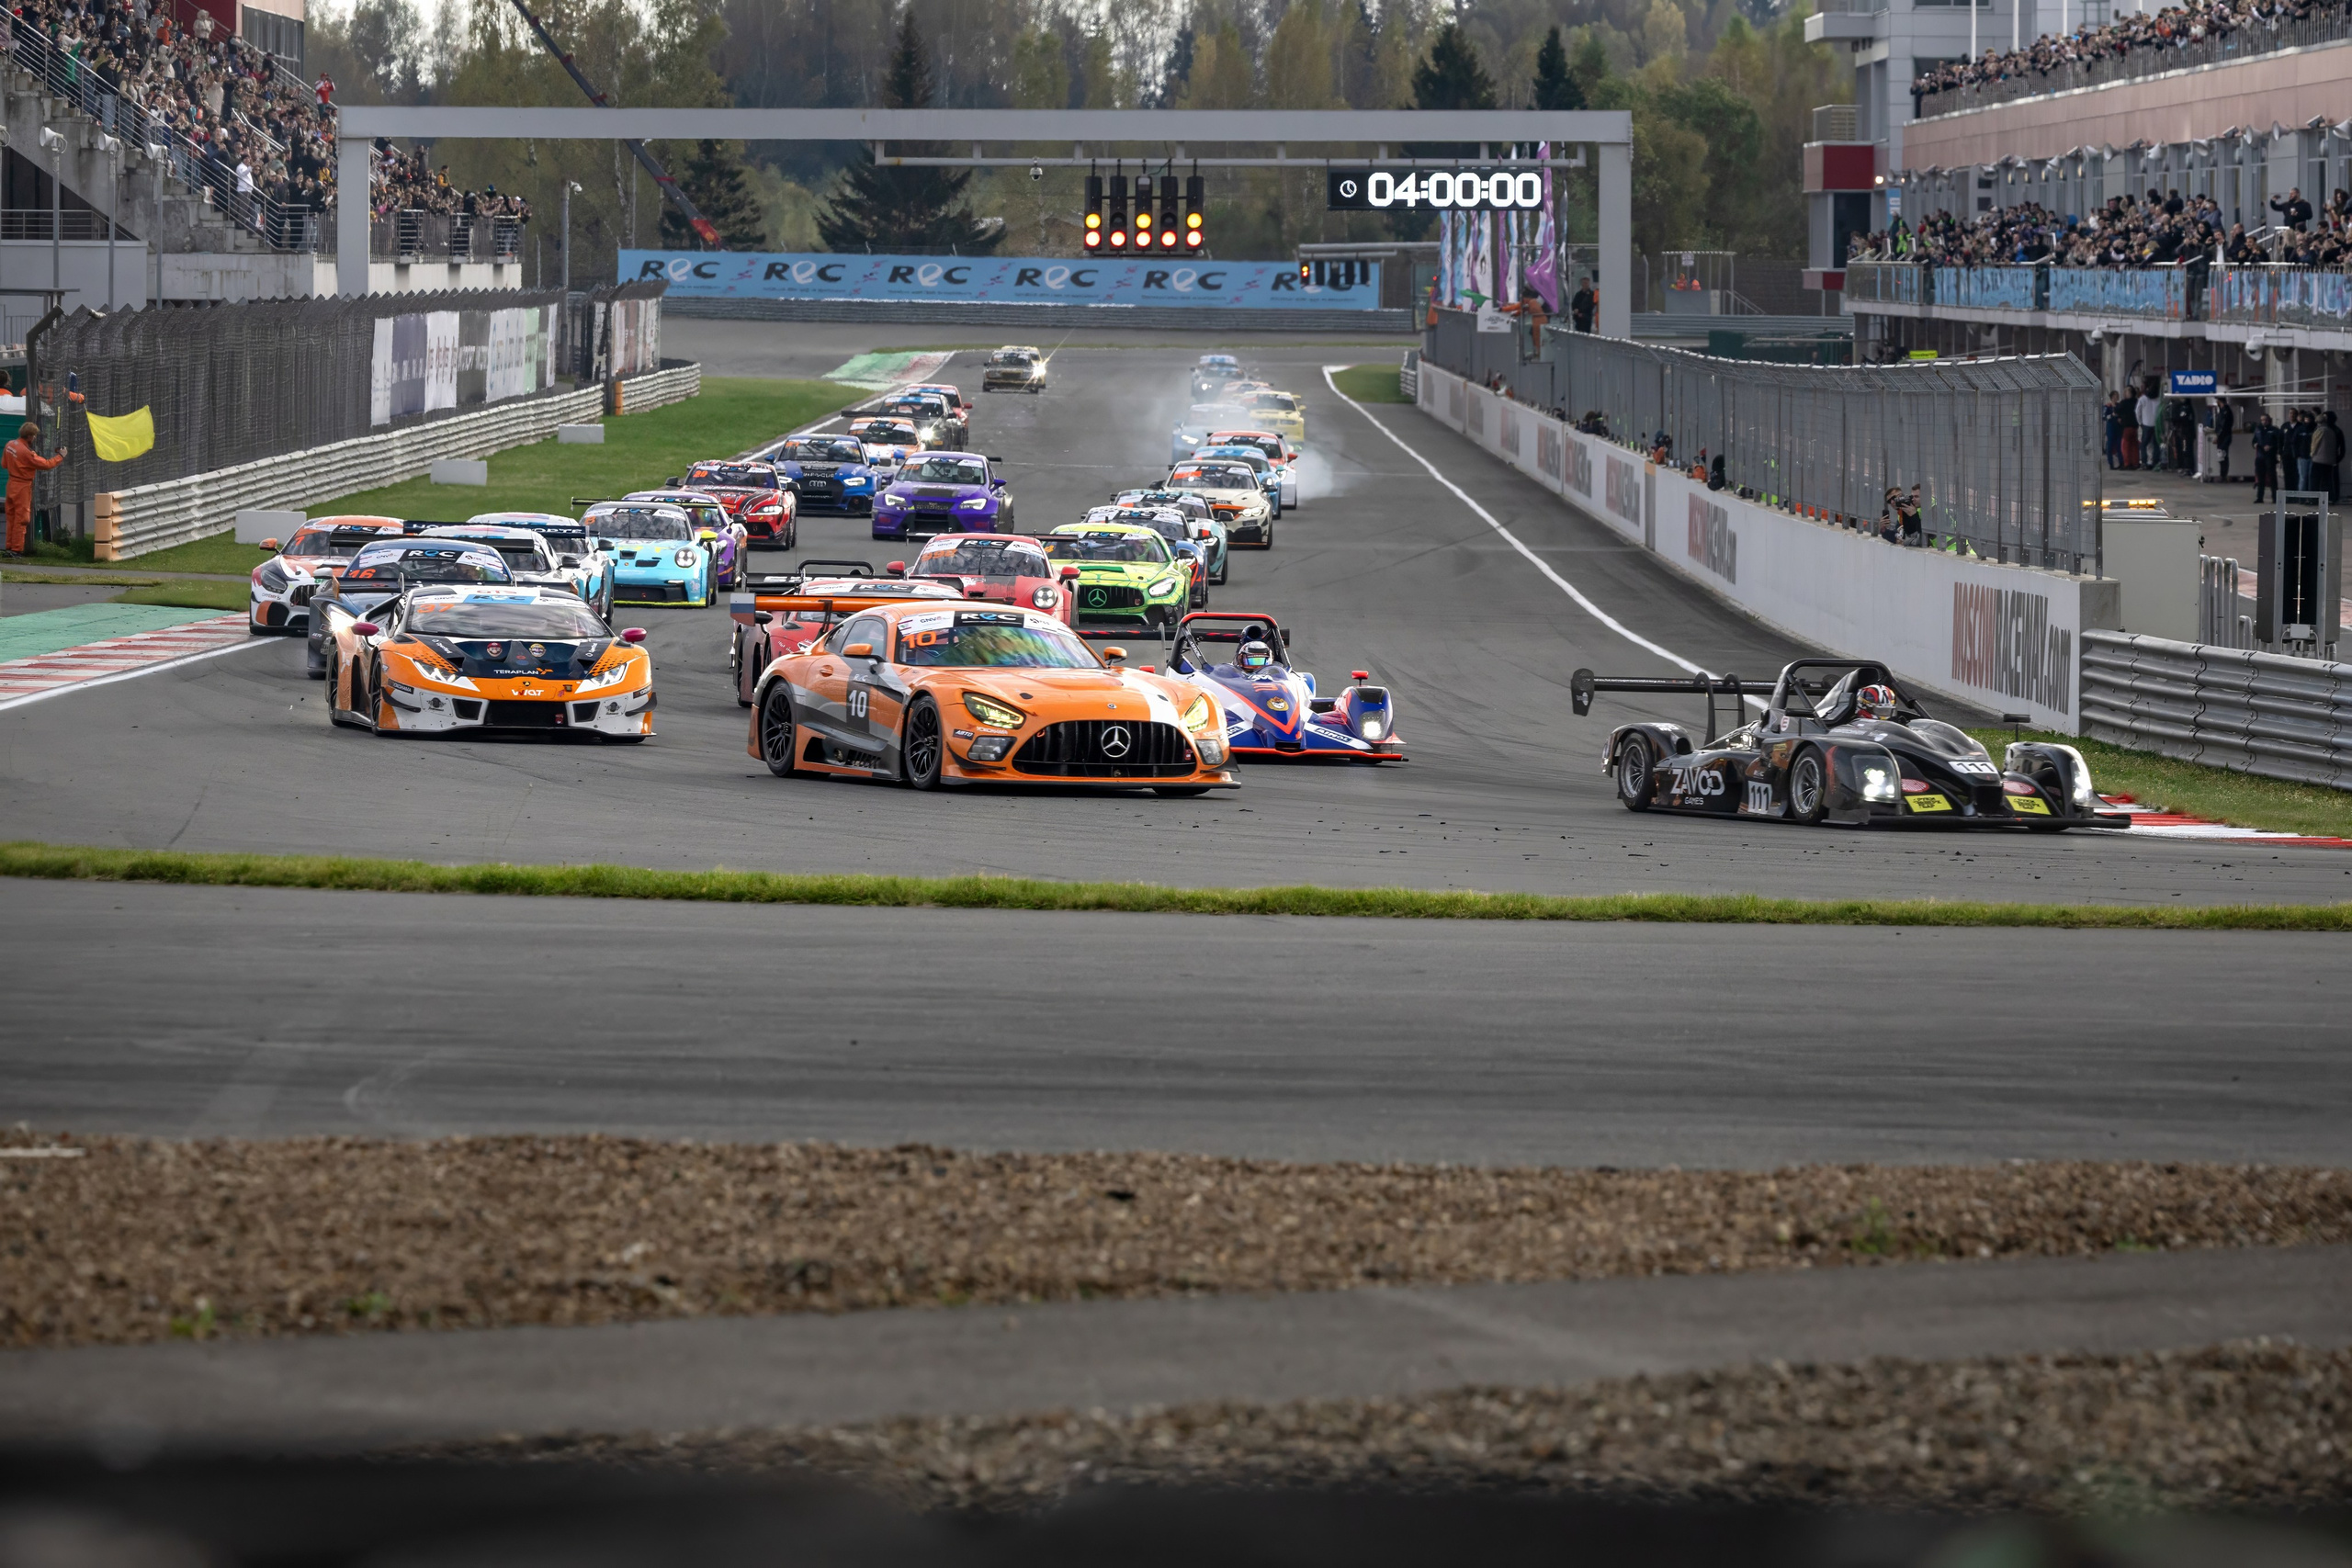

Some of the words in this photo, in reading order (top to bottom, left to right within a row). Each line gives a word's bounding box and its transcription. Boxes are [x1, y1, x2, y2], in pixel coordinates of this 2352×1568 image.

[1368, 172, 1542, 207] 04:00:00
[900, 631, 937, 649] 10
[848, 689, 868, 718] 10
[1669, 766, 1725, 795] ZAVOD
[1957, 762, 1996, 773] 111
[1750, 784, 1770, 811] 111
